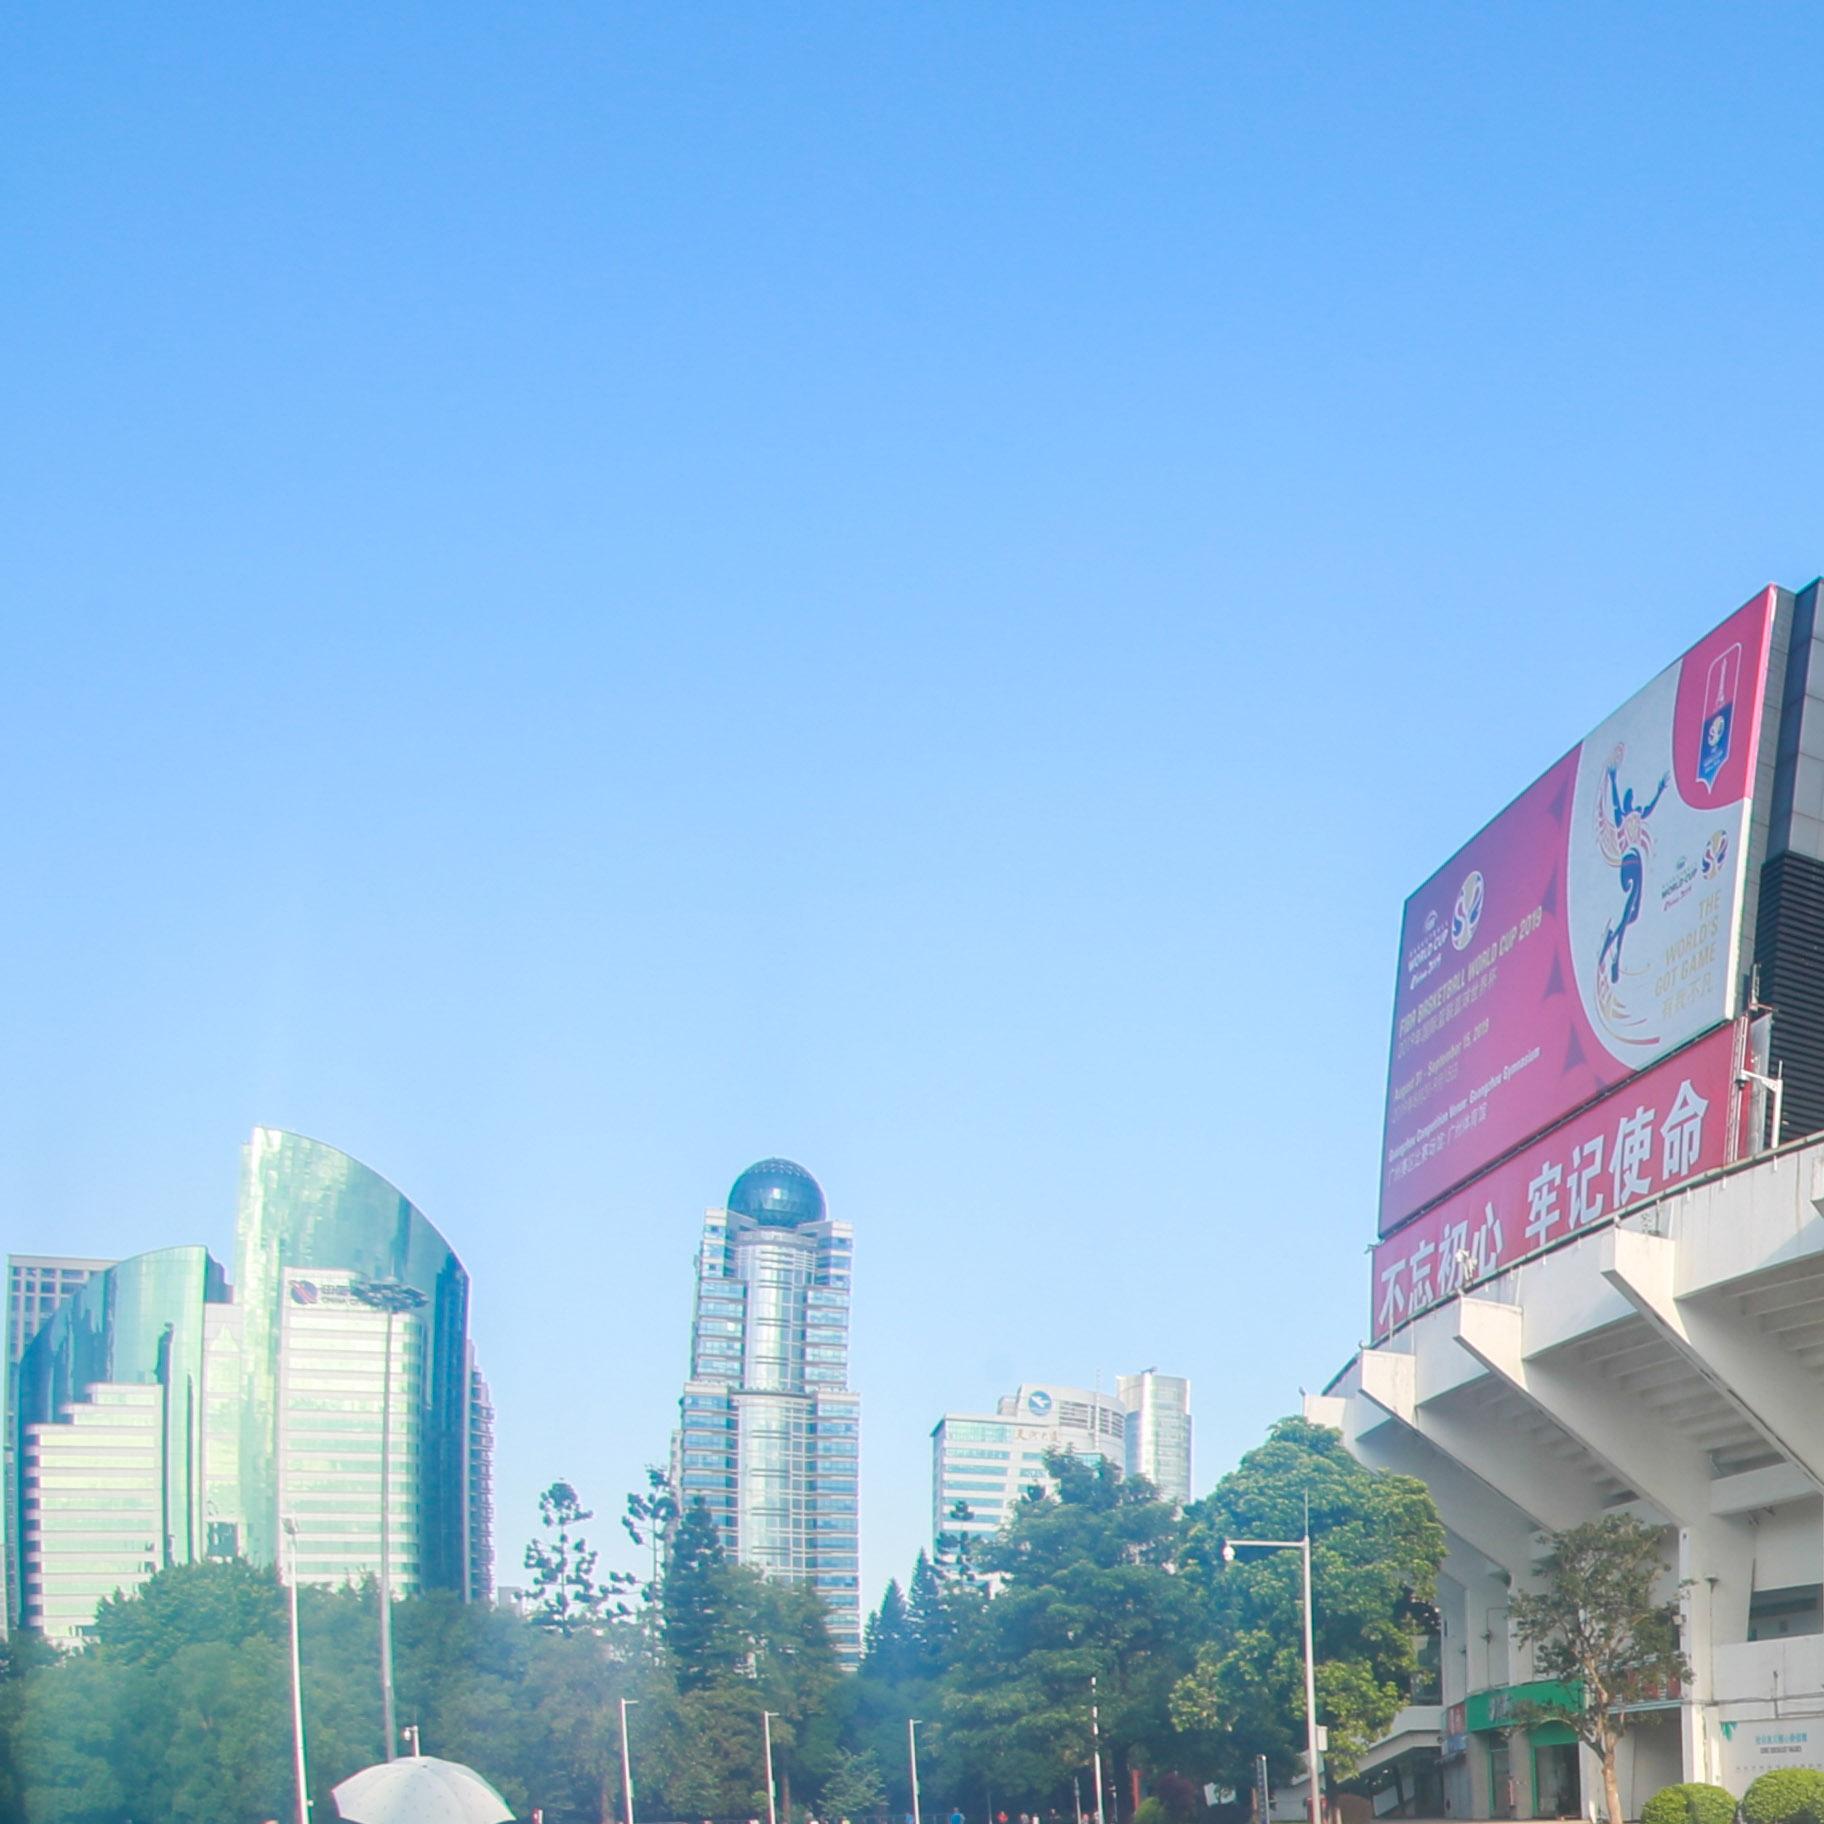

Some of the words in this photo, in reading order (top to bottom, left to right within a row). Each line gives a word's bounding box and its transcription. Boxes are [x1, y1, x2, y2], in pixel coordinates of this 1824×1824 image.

[1699, 890, 1721, 919] THE
[1416, 968, 1465, 1022] BASKETBALL
[1467, 942, 1498, 982] WORLD
[1499, 925, 1518, 957] CUP
[1518, 905, 1543, 941] 2019
[1665, 915, 1719, 965] WORLD'S
[1655, 965, 1677, 997] GOT
[1680, 943, 1716, 980] GAME
[1378, 1202, 1504, 1326] 不忘初心
[1525, 1078, 1709, 1247] 牢记使命
